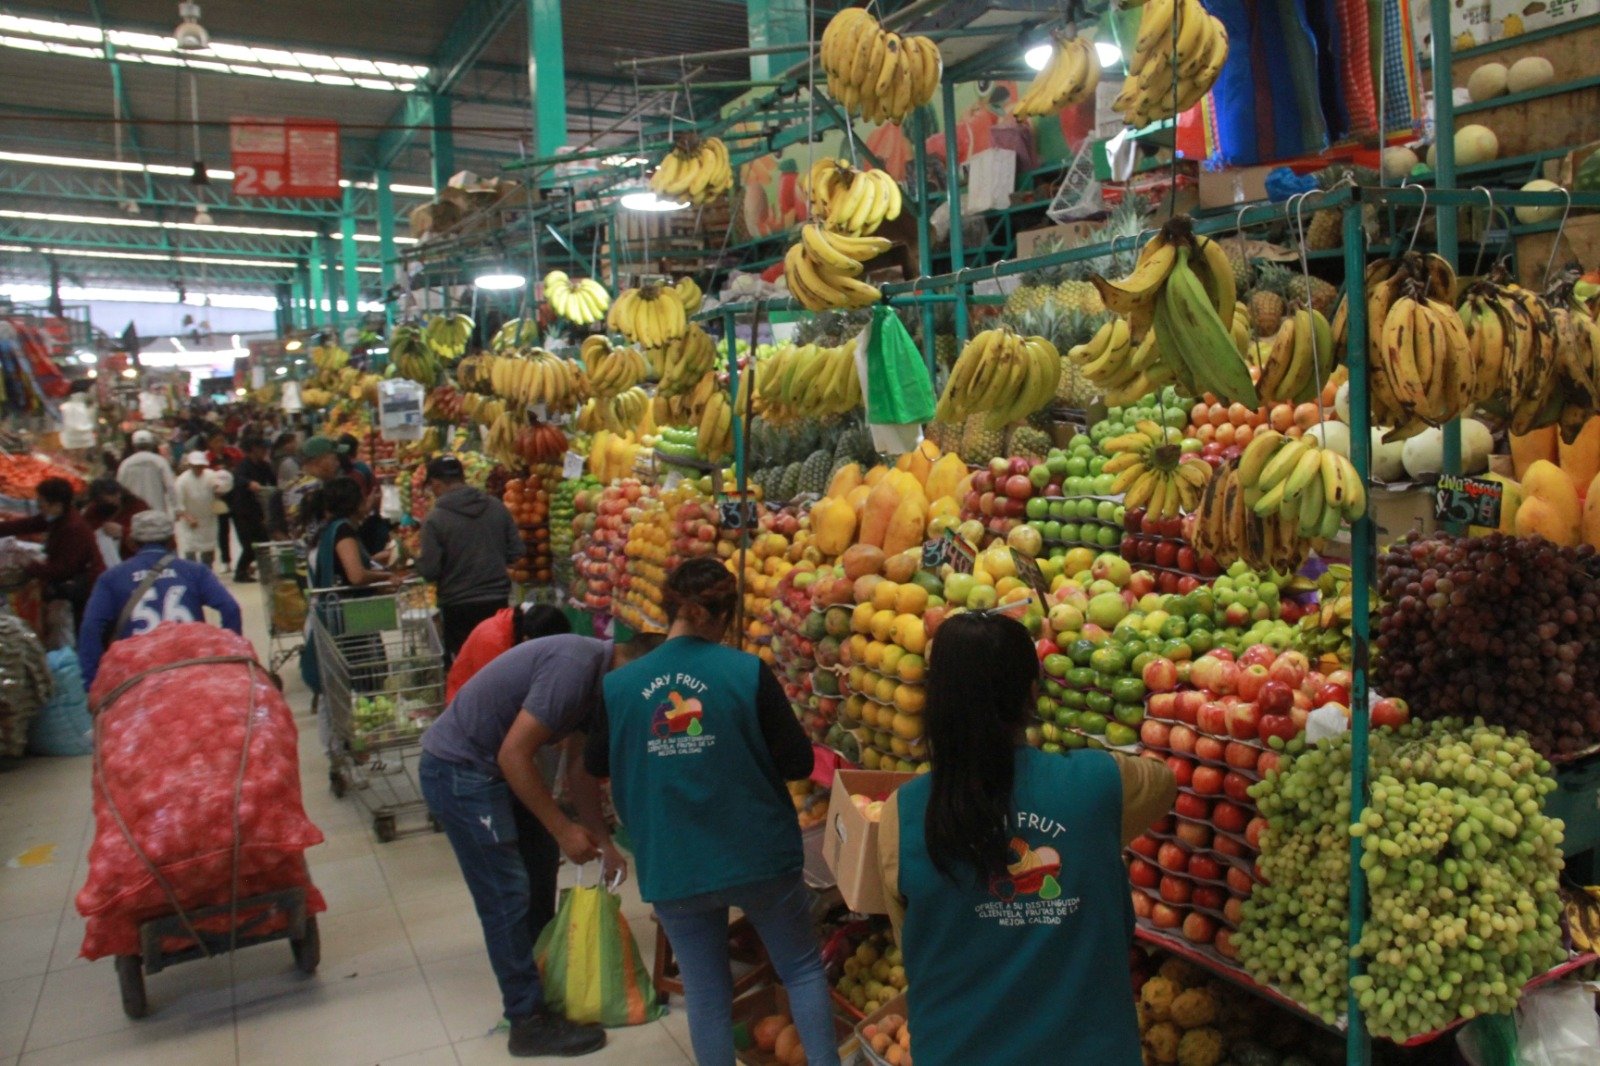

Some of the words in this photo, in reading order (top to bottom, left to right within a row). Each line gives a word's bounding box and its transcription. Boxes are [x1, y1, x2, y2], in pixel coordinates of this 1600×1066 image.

[235, 166, 258, 194] 2
[130, 585, 194, 635] 56
[641, 673, 671, 700] MARY
[676, 673, 708, 693] FRUT
[1017, 811, 1067, 838] FRUT
[1012, 902, 1023, 910] SU
[1025, 907, 1054, 917] FRUTAS
[1057, 907, 1067, 916] DE
[999, 918, 1026, 926] MEJOR
[1028, 916, 1062, 925] CALIDAD
